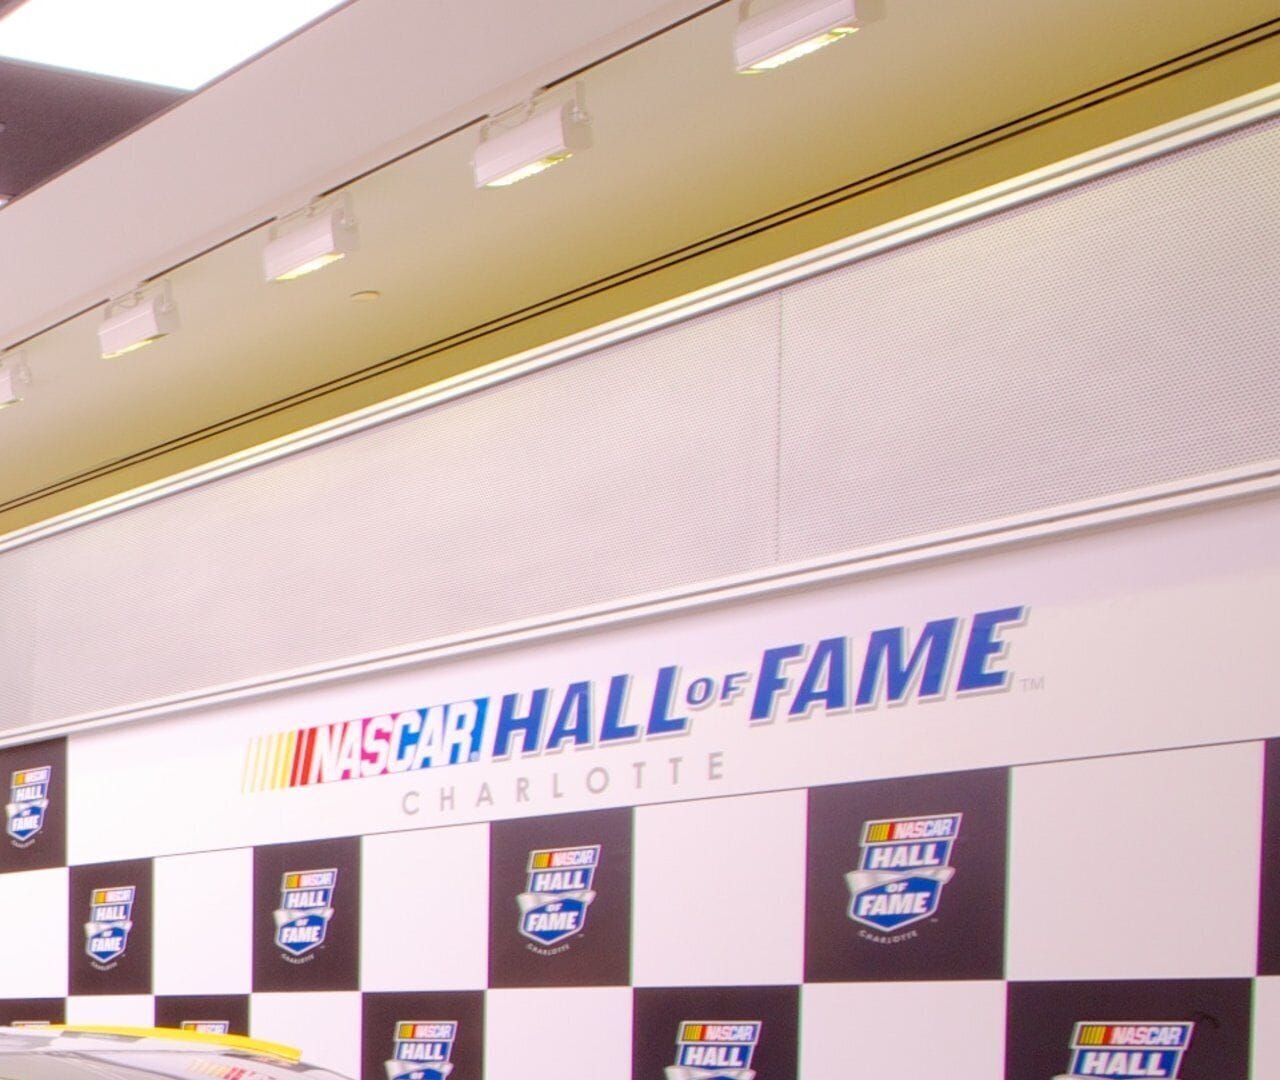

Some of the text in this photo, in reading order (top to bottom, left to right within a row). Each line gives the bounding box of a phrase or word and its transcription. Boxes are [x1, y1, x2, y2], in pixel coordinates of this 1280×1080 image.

[309, 698, 481, 785] NASCAR
[492, 665, 686, 759] HALL
[686, 671, 751, 707] OF
[749, 605, 1026, 722] FAME
[402, 751, 725, 816] CHARLOTTE
[894, 819, 953, 839] NASCAR
[870, 843, 939, 869] HALL
[535, 870, 585, 891] HALL
[885, 882, 909, 893] OF
[287, 891, 326, 908] HALL
[546, 903, 563, 912] OF
[859, 892, 930, 916] FAME
[96, 905, 126, 921] HALL
[526, 911, 578, 932] FAME
[91, 937, 123, 952] FAME
[282, 926, 321, 943] FAME
[706, 1025, 754, 1041] NASCAR
[1111, 1026, 1181, 1046] NASCAR
[400, 1043, 444, 1060] HALL
[684, 1046, 743, 1067] HALL
[1081, 1051, 1166, 1077] HALL
